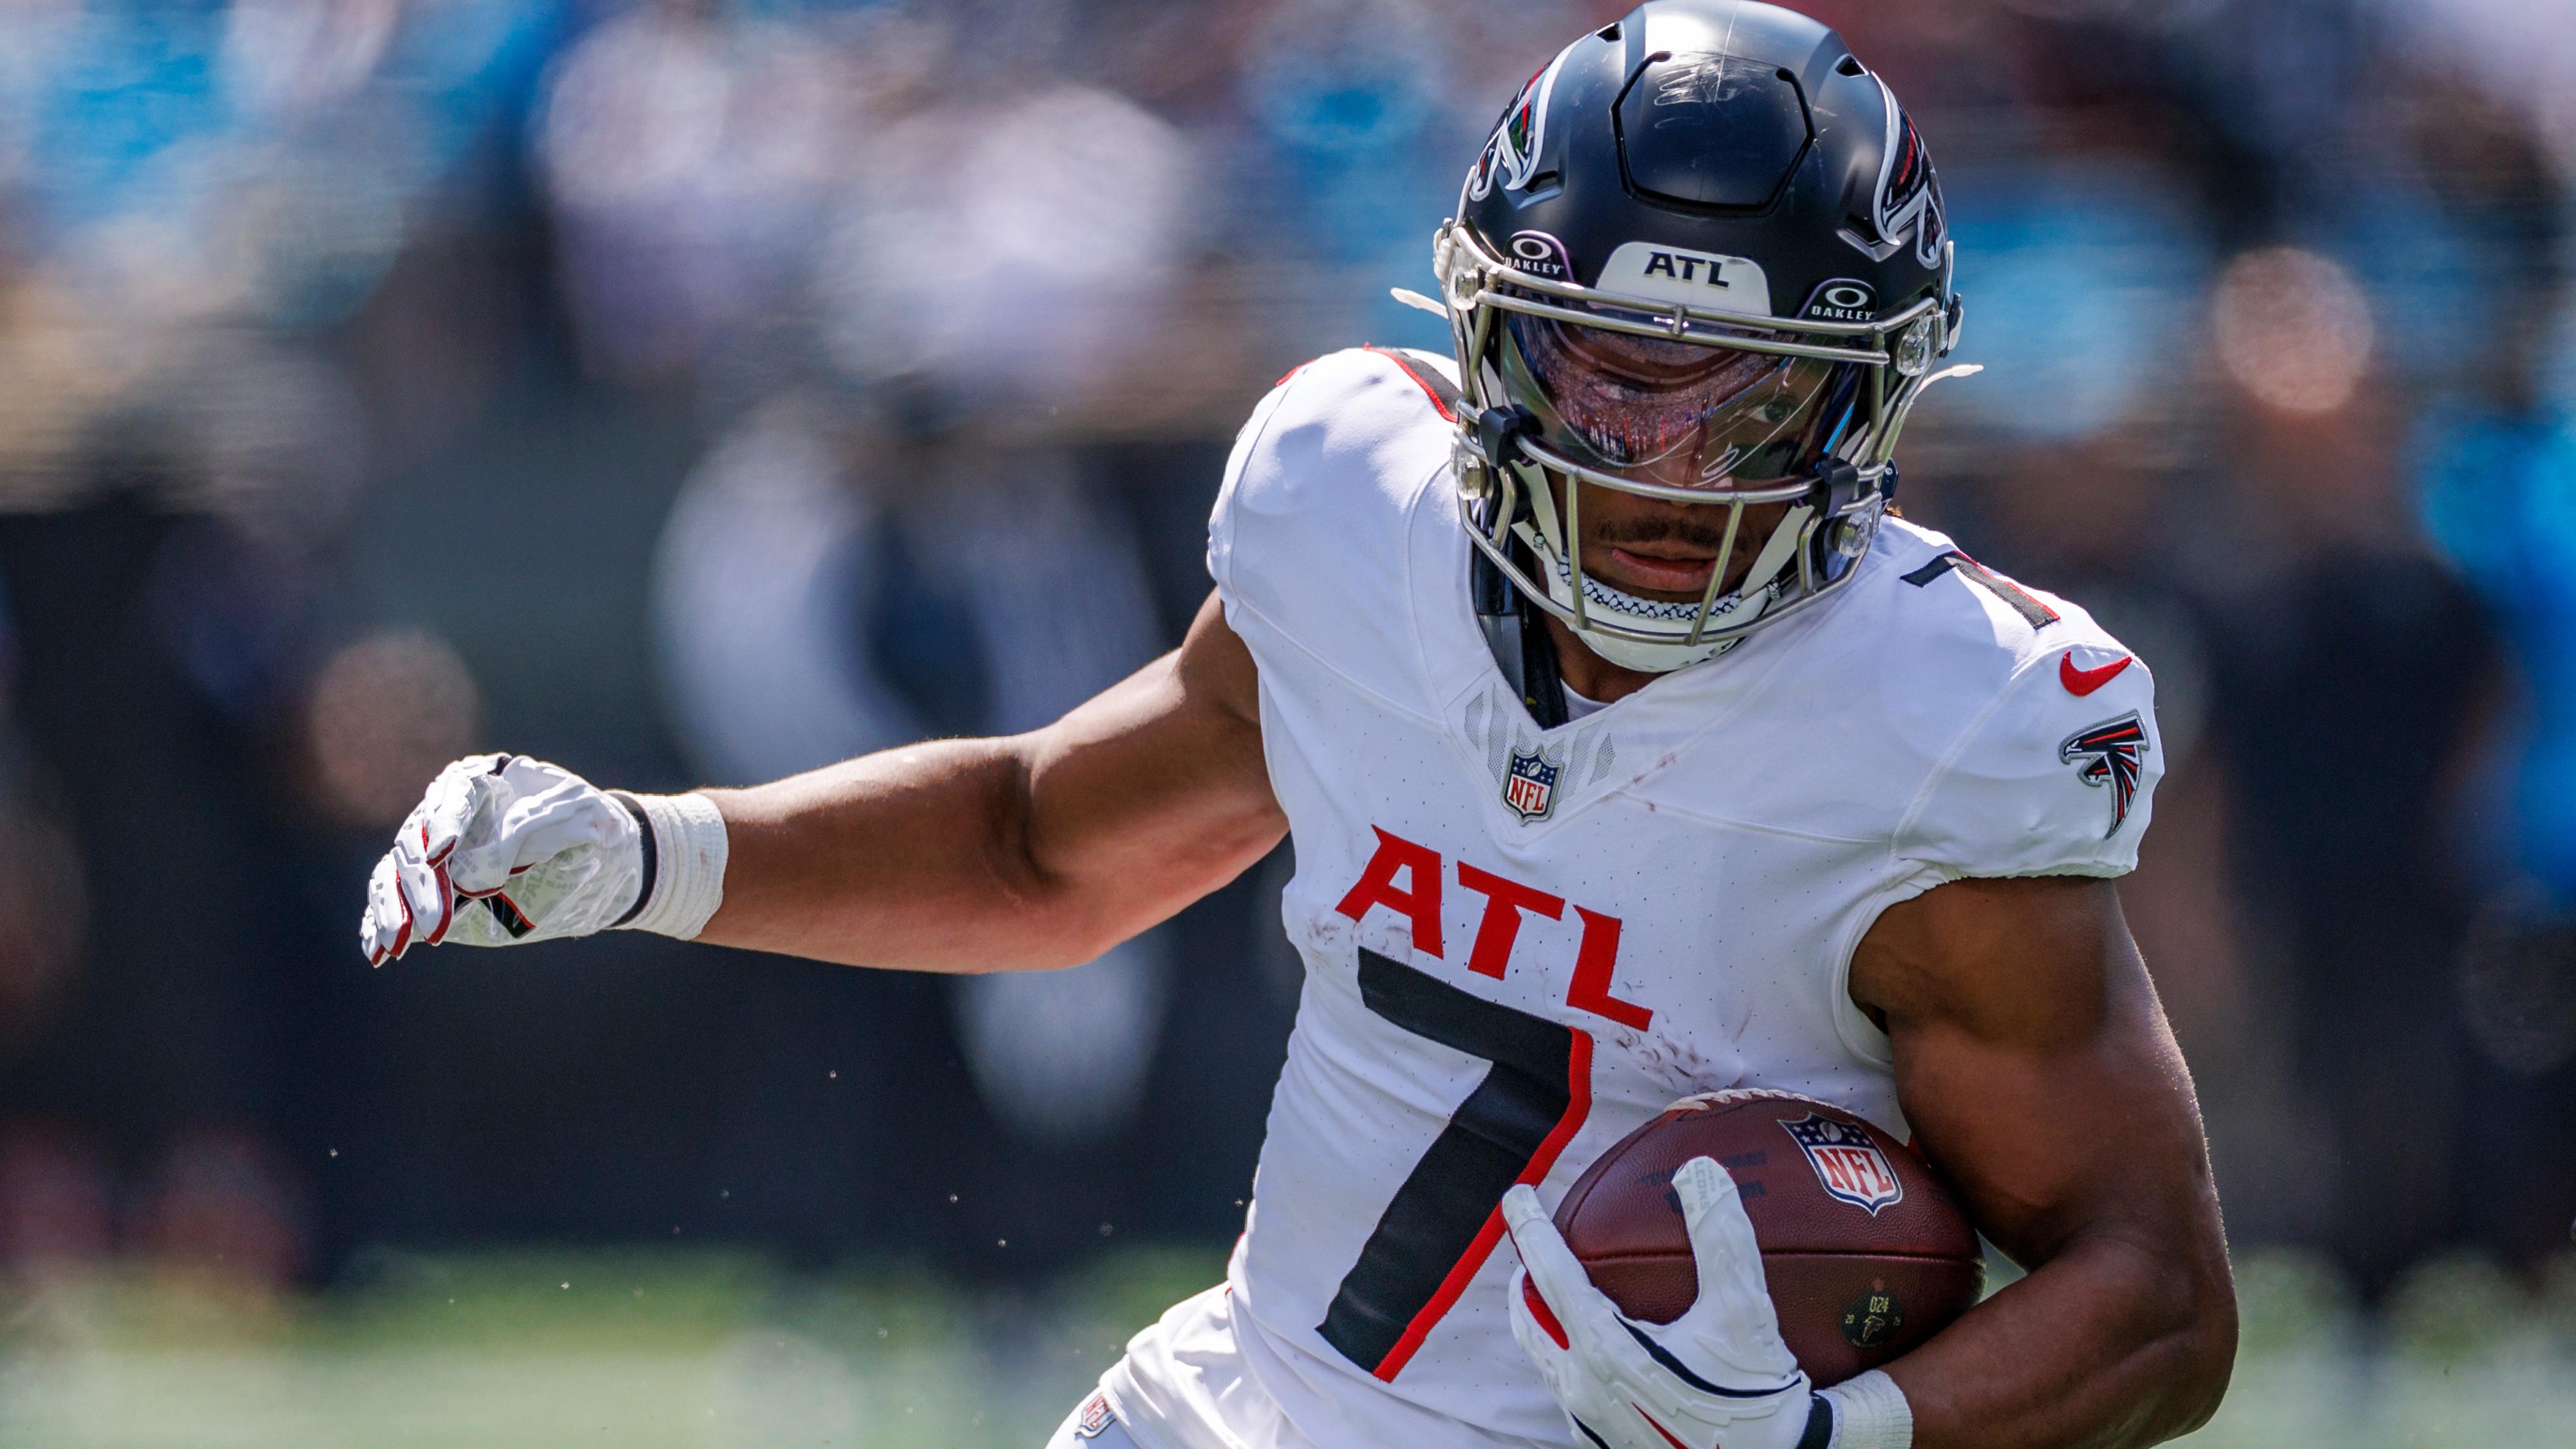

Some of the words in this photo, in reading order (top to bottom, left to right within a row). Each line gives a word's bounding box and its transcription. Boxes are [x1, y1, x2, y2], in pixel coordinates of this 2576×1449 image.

[1504, 257, 1561, 274] OAKLEY
[1643, 251, 1729, 288] ATL
[1811, 305, 1873, 320] OAKLEY
[1900, 550, 2060, 630] 7
[1508, 776, 1545, 811] NFL
[1334, 824, 1653, 1032] ATL
[1314, 945, 1593, 1383] 7
[1813, 1148, 1893, 1198] NFL
